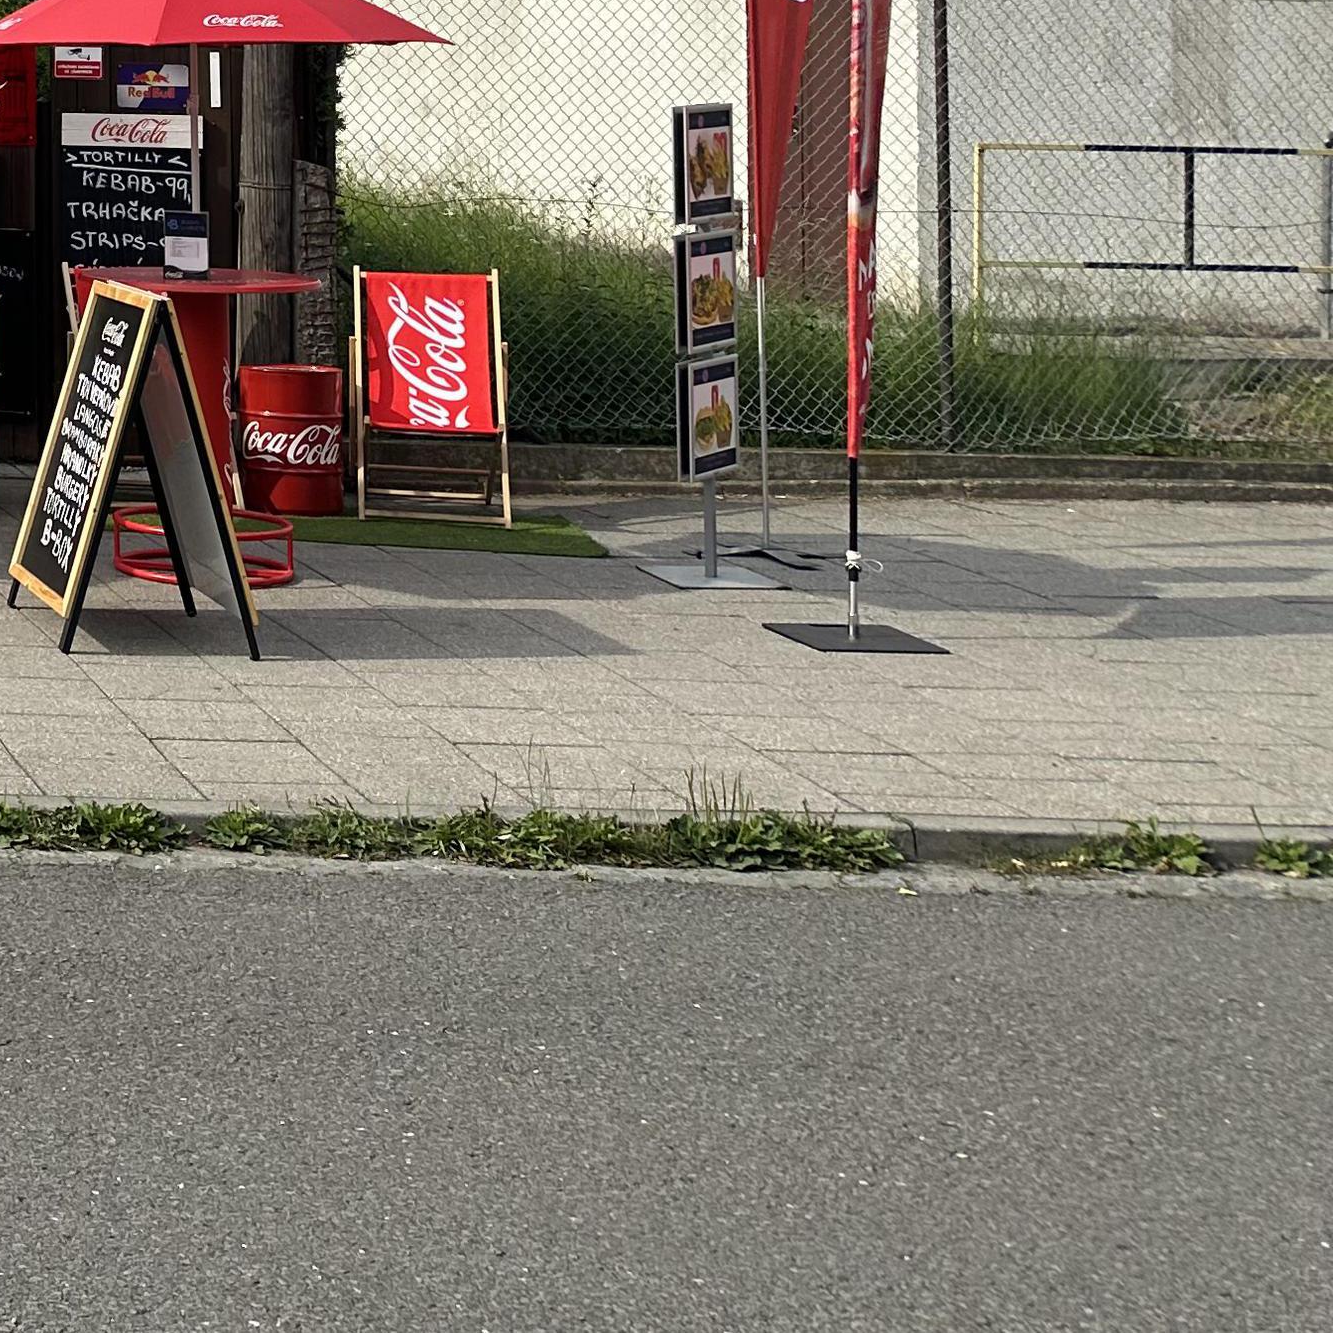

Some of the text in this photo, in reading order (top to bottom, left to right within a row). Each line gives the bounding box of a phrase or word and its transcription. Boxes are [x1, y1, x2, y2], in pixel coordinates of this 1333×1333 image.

[202, 14, 284, 29] Coca-Cola
[91, 117, 172, 145] Coca-Cola
[79, 151, 162, 165] TORTILLY
[91, 353, 121, 393] KEBAB
[242, 420, 342, 466] Coca-Cola
[53, 464, 90, 513] BURGERY
[42, 486, 82, 538] TORTILLY
[40, 518, 74, 574] B-BOX
